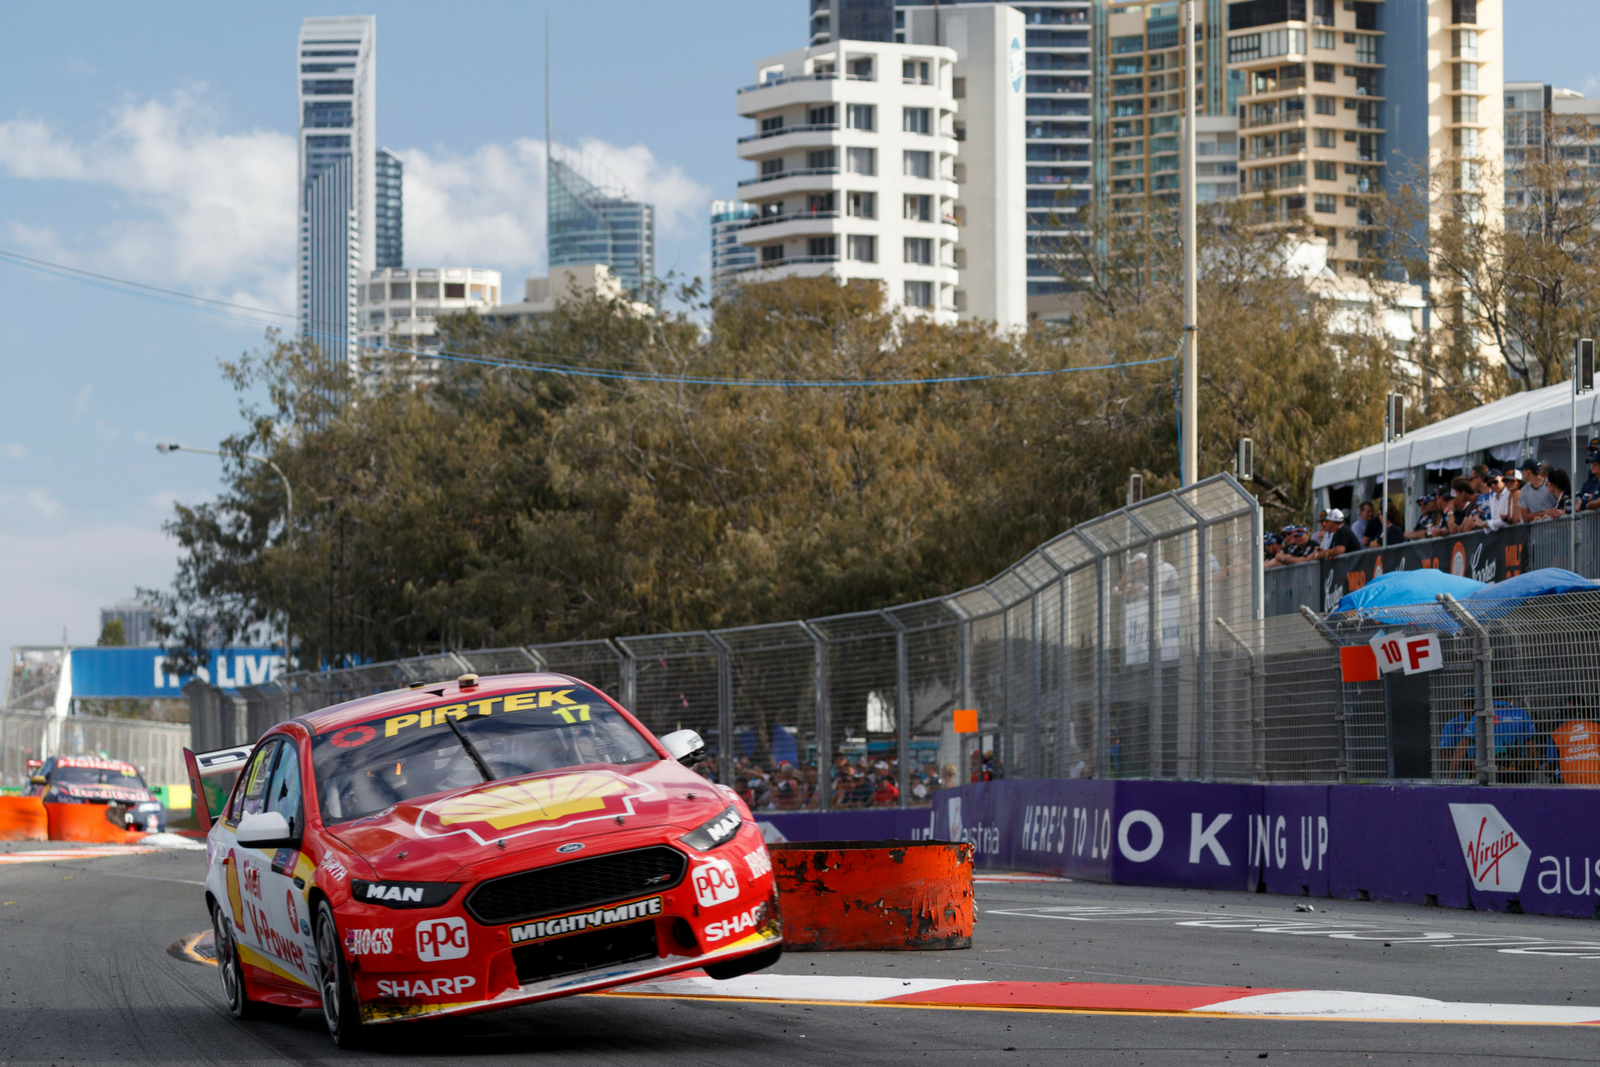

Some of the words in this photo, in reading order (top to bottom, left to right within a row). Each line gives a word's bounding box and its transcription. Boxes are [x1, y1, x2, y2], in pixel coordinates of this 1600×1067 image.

[1381, 640, 1402, 665] 10
[1406, 638, 1430, 671] F
[385, 689, 577, 738] PIRTEK
[552, 704, 592, 724] 17
[1022, 805, 1068, 855] HERE'S
[1072, 807, 1088, 858] TO
[1301, 815, 1329, 871] UP
[1466, 816, 1519, 886] Virgin
[1537, 855, 1600, 896] au
[366, 884, 425, 902] MAN
[246, 900, 308, 975] V-Power
[353, 928, 394, 956] HOGS
[418, 921, 467, 957] PPG
[376, 975, 477, 998] SHARP
